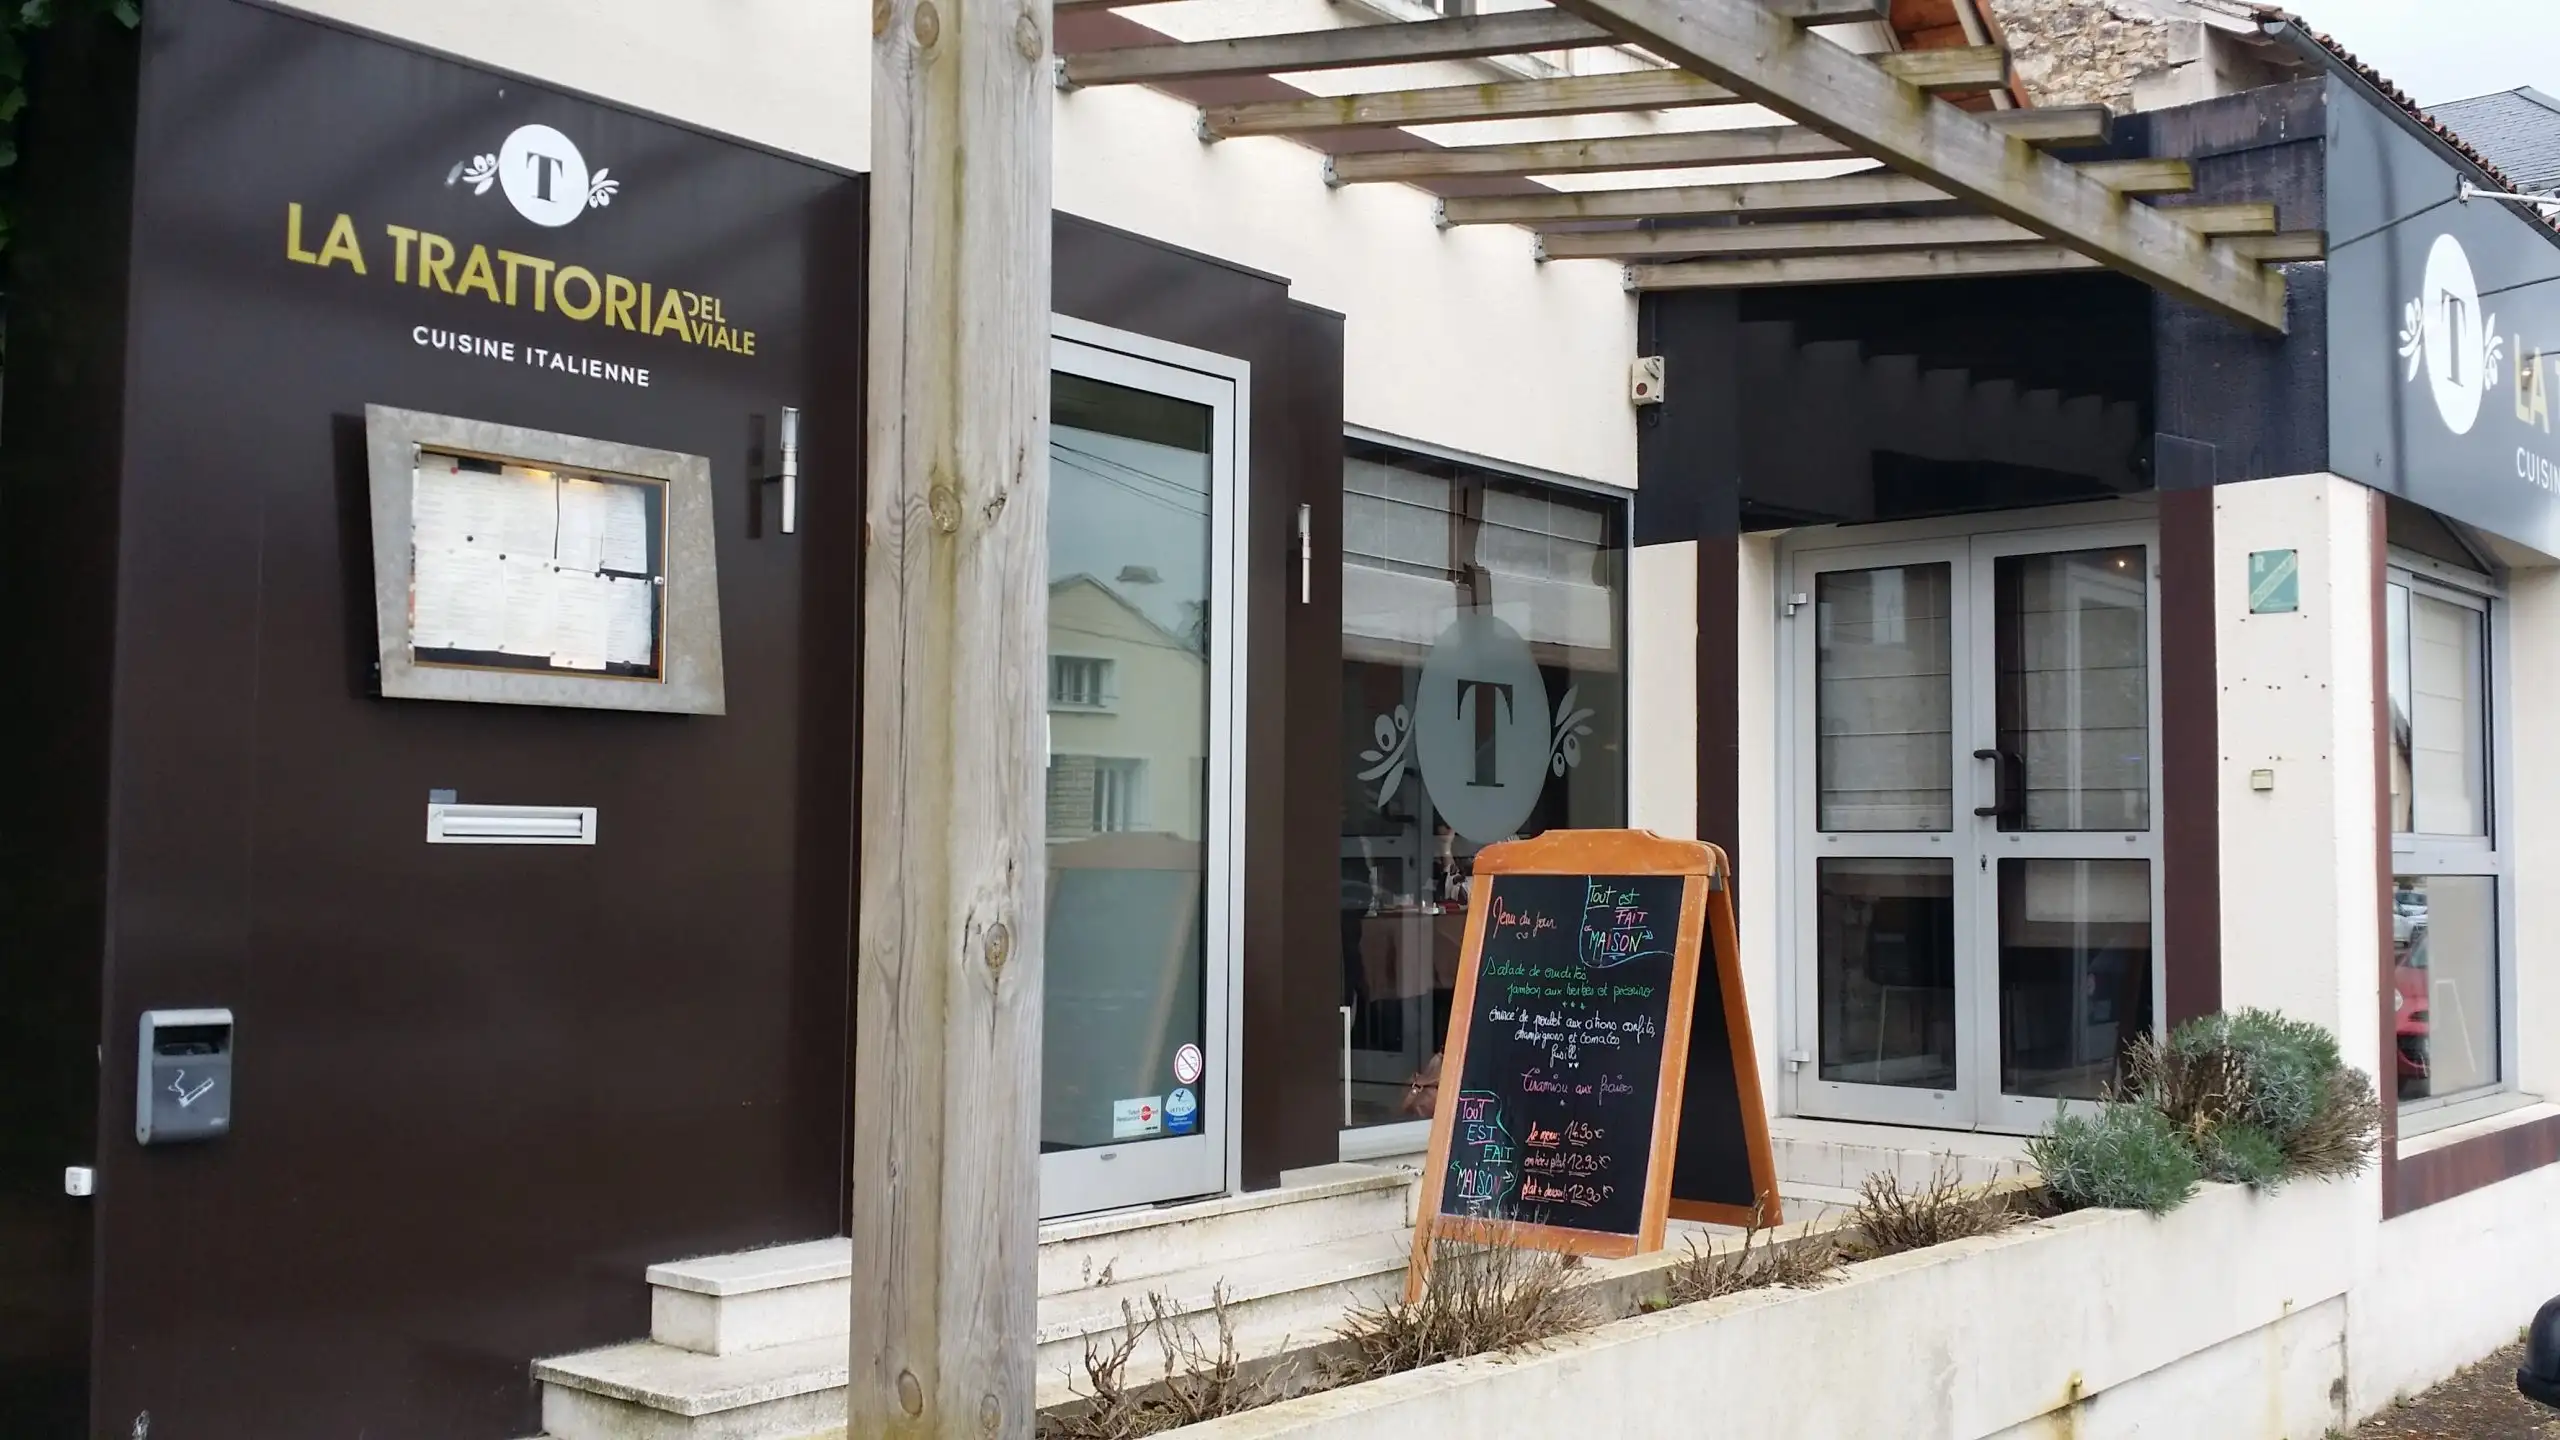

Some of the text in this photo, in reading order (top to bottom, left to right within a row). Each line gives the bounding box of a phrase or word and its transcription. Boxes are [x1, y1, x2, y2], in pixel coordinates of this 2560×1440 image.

[526, 152, 563, 203] T
[286, 202, 692, 344] LA TRATTORIA
[681, 290, 726, 324] DEL
[690, 318, 756, 356] VIALE
[412, 325, 650, 387] CUISINE ITALIENNE
[2513, 333, 2550, 434] LA
[1457, 679, 1513, 787] T
[1589, 884, 1640, 906] Tout est
[1519, 909, 1531, 925] du
[1533, 911, 1557, 938] jour
[1614, 908, 1649, 928] FAIT
[1481, 956, 1526, 977] Salade
[1528, 964, 1541, 977] de
[1506, 980, 1541, 1004] jambon
[1544, 987, 1562, 996] aux
[1597, 982, 1608, 996] et
[1518, 1009, 1529, 1023] de
[1533, 1010, 1562, 1032] poulet
[1566, 1017, 1582, 1029] aux
[1585, 1010, 1617, 1031] citrons
[1514, 1026, 1564, 1049] champignons
[1568, 1031, 1578, 1043] et
[1575, 1084, 1593, 1095] aux
[1466, 1124, 1498, 1142] EST
